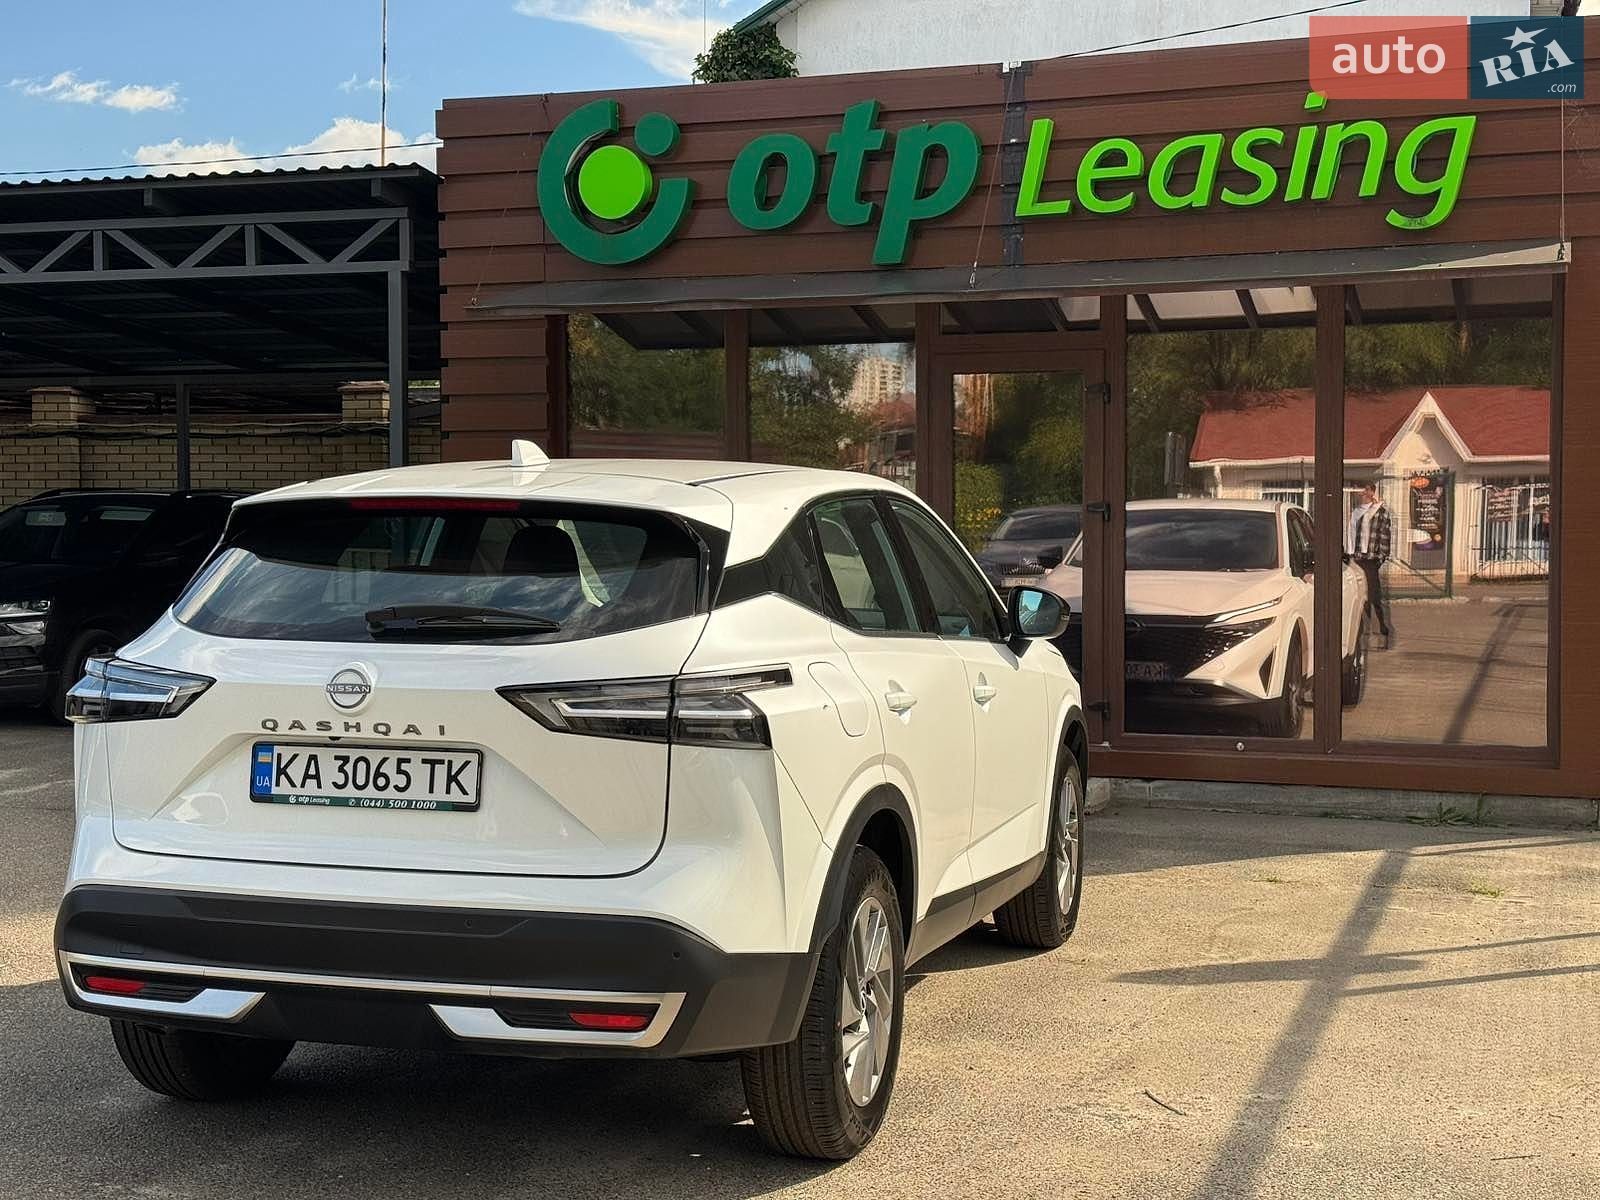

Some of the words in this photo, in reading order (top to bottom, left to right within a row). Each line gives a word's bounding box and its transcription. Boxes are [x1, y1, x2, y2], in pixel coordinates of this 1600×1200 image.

[727, 98, 982, 265] otp
[1015, 91, 1477, 230] Leasing
[326, 684, 371, 694] NISSAN
[261, 718, 446, 736] QASHQAI
[256, 775, 271, 787] UA
[274, 753, 322, 789] KA
[331, 755, 412, 793] 3065
[421, 758, 472, 796] TK
[360, 798, 384, 808] (044)
[389, 799, 407, 809] 500
[411, 800, 436, 810] 1000
